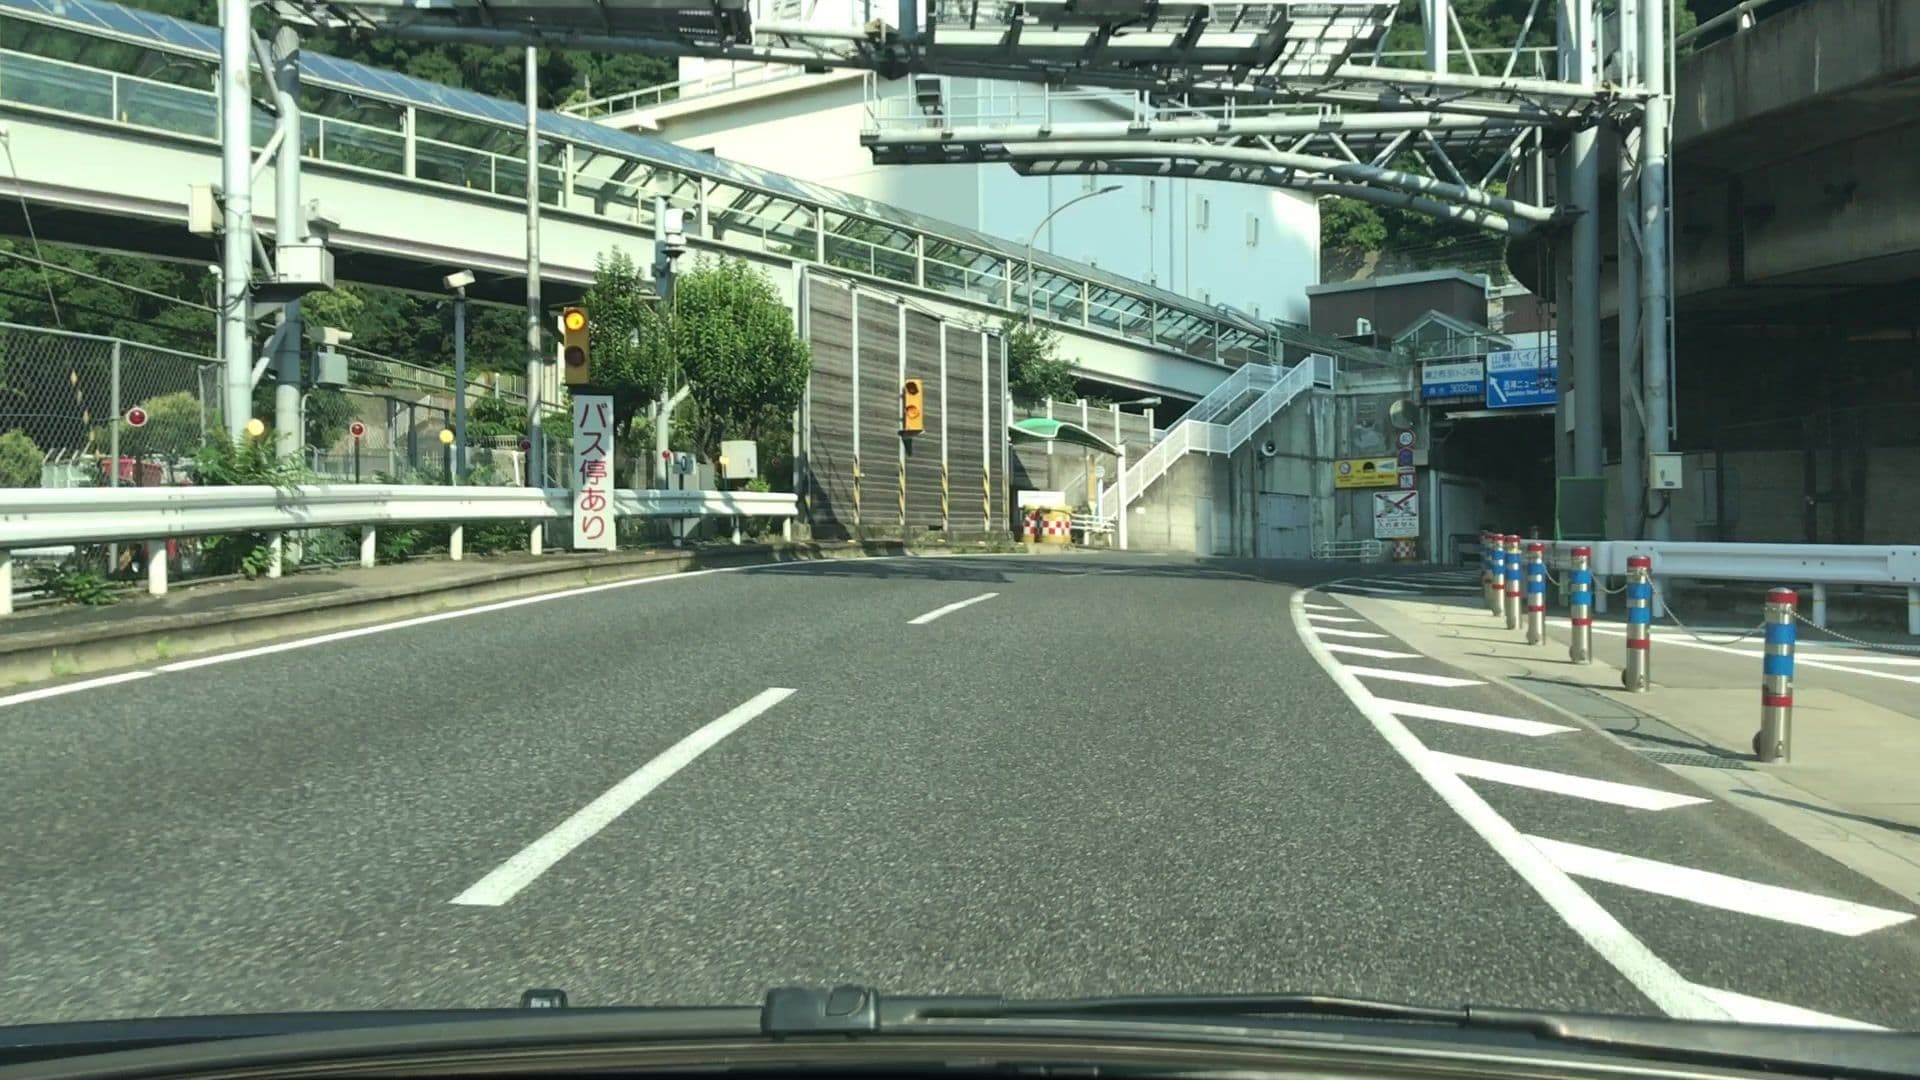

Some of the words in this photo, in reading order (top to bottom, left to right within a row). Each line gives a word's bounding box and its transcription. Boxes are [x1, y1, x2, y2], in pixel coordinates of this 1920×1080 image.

[579, 403, 607, 540] バス停あり
